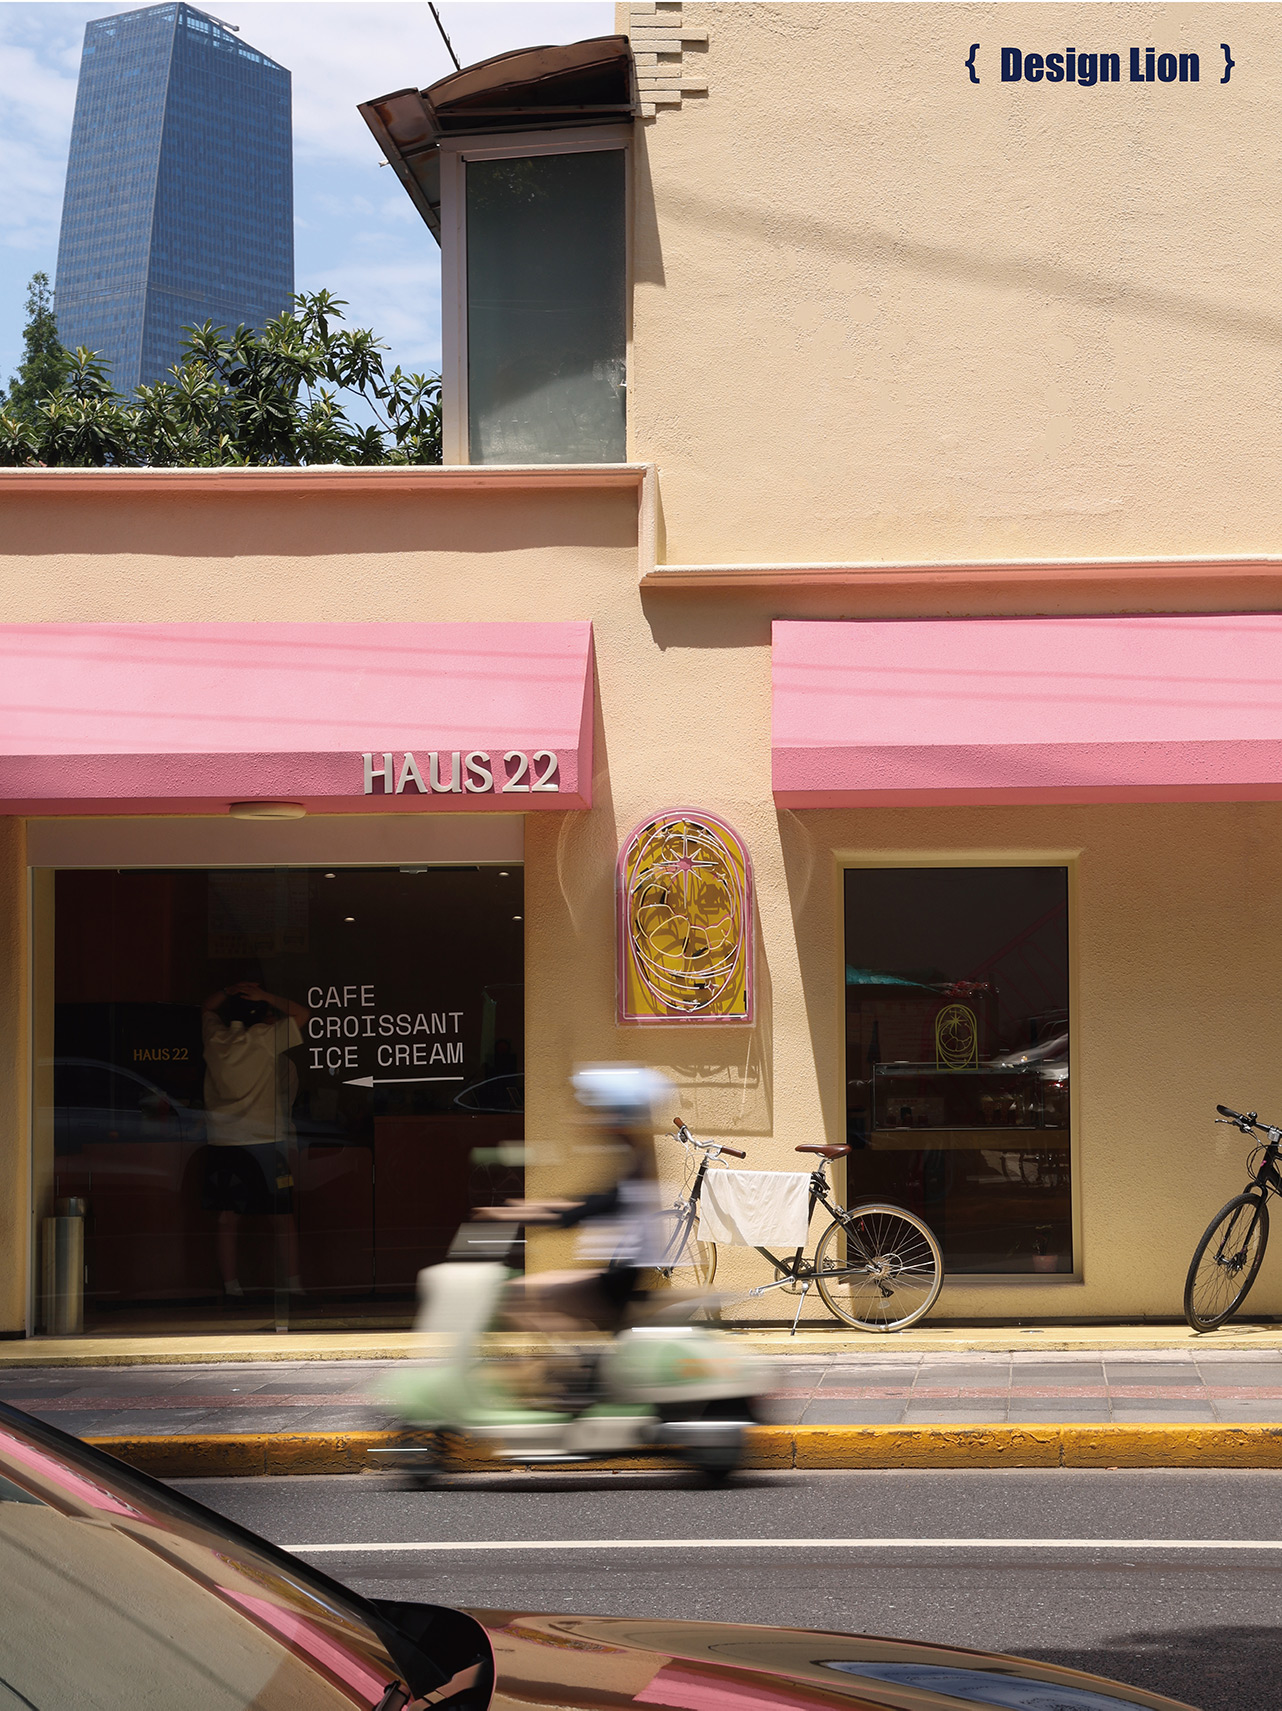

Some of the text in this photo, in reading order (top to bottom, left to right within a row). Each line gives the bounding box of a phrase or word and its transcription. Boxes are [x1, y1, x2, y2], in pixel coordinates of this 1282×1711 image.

[362, 750, 559, 794] HAUS 22
[307, 984, 375, 1008] CAFE
[308, 1011, 464, 1039] CROISSANT
[133, 1047, 189, 1061] HAUS 22
[309, 1042, 464, 1069] ICE CREAM
